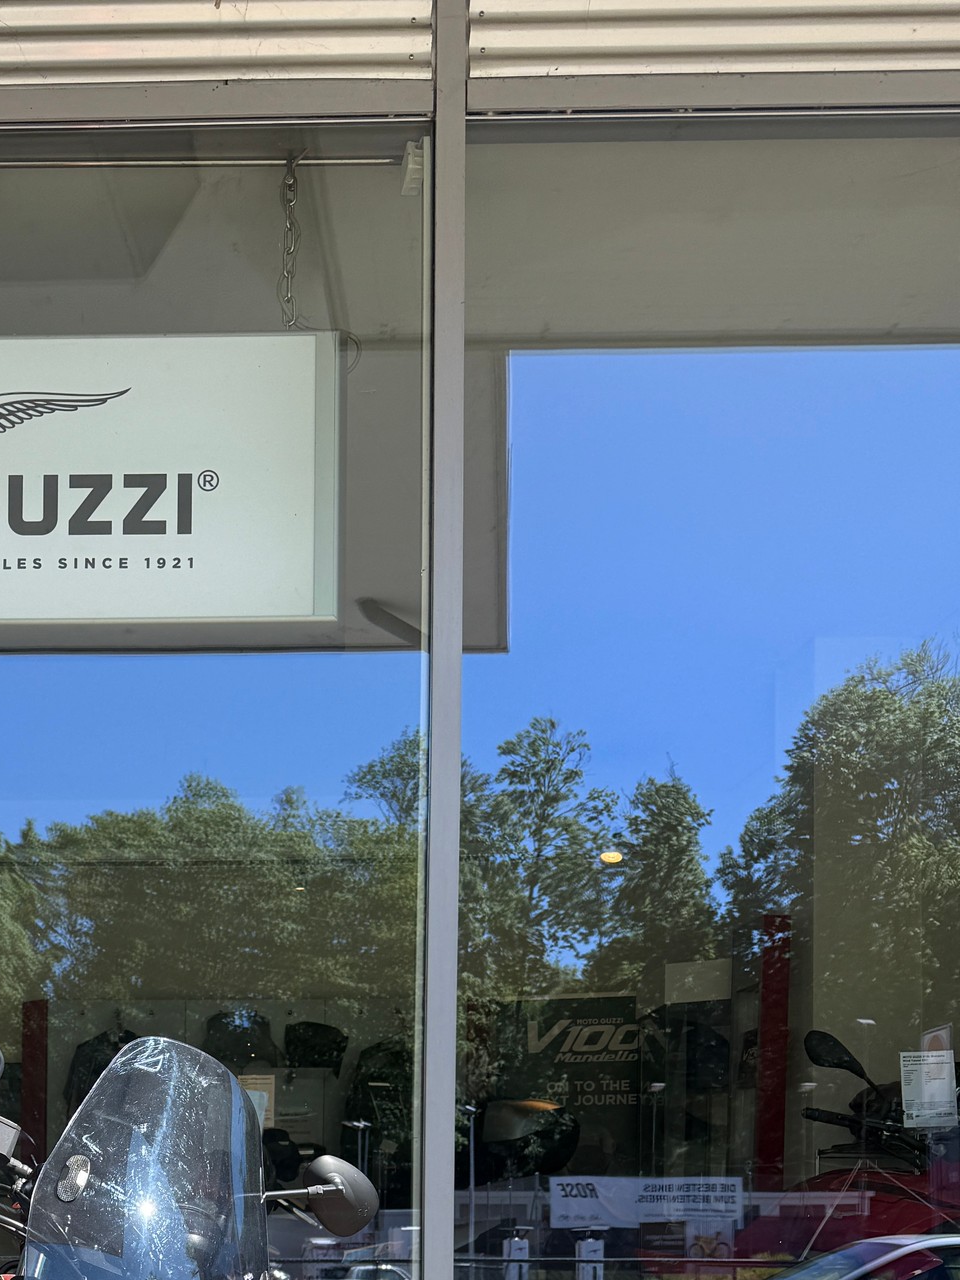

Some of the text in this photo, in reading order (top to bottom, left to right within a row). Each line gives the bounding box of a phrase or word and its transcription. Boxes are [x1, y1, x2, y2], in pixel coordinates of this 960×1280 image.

[58, 557, 129, 570] SINCE
[144, 557, 195, 569] 1921
[600, 1017, 624, 1025] GUZZI
[554, 1051, 640, 1063] Mandello
[574, 1081, 595, 1092] TO
[600, 1080, 631, 1091] THE
